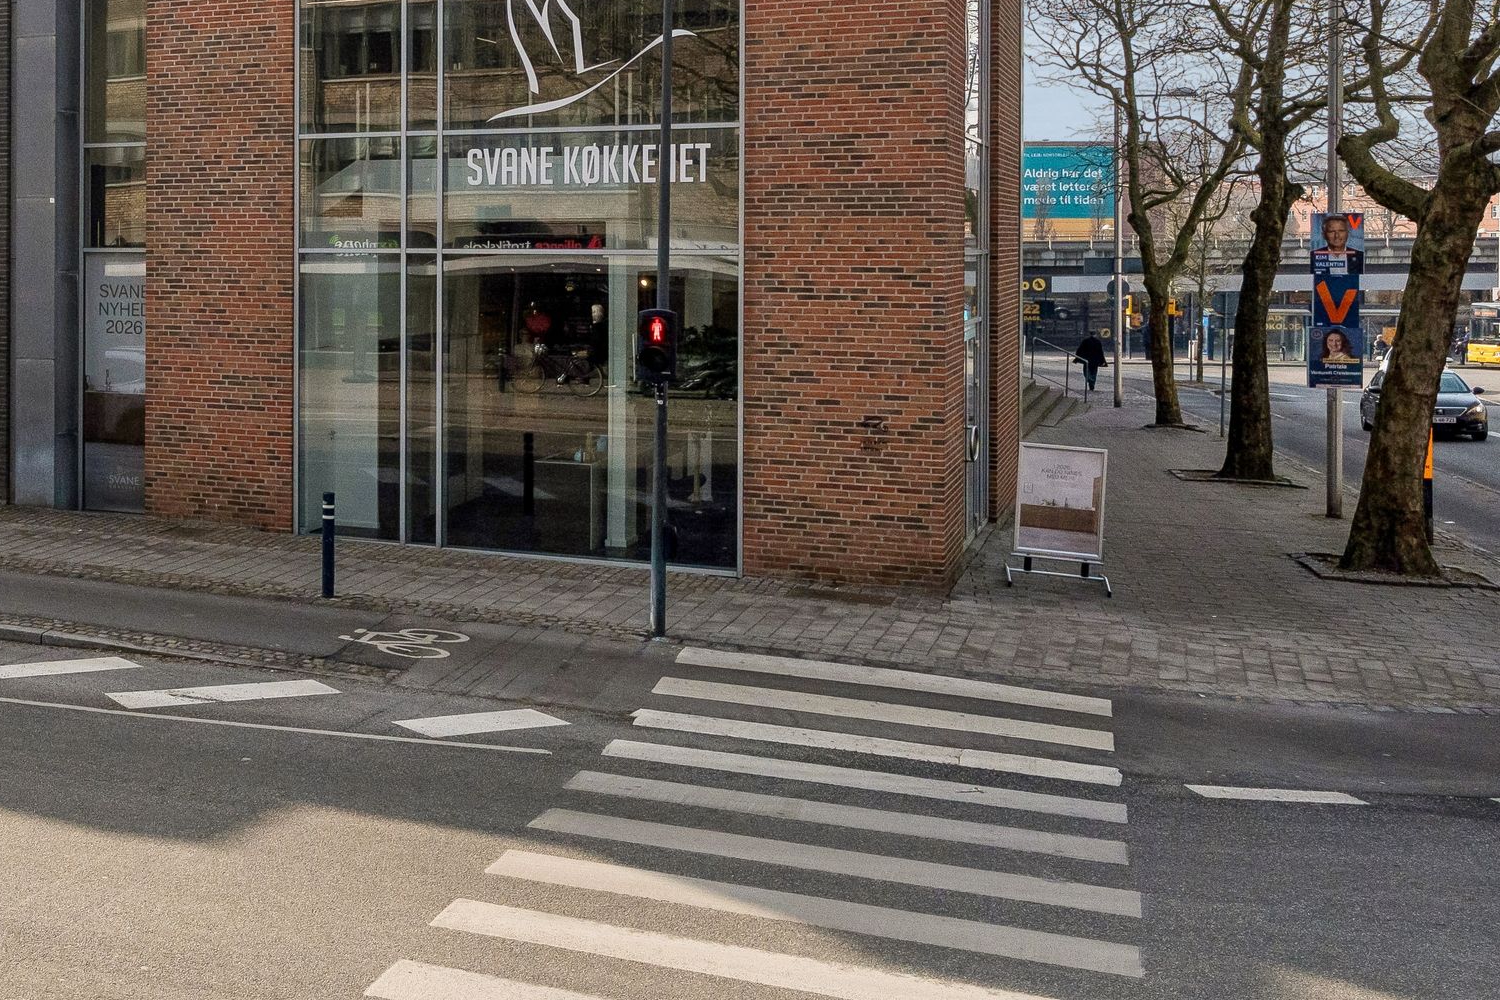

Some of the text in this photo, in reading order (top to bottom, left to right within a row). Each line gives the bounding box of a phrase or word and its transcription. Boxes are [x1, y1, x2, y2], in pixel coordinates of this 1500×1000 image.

[467, 146, 554, 186] SVANE
[1024, 168, 1103, 180] Aldrig har det
[1060, 195, 1071, 204] til
[1074, 195, 1104, 204] tiden
[106, 320, 143, 334] 2026
[109, 475, 140, 486] SVANE
